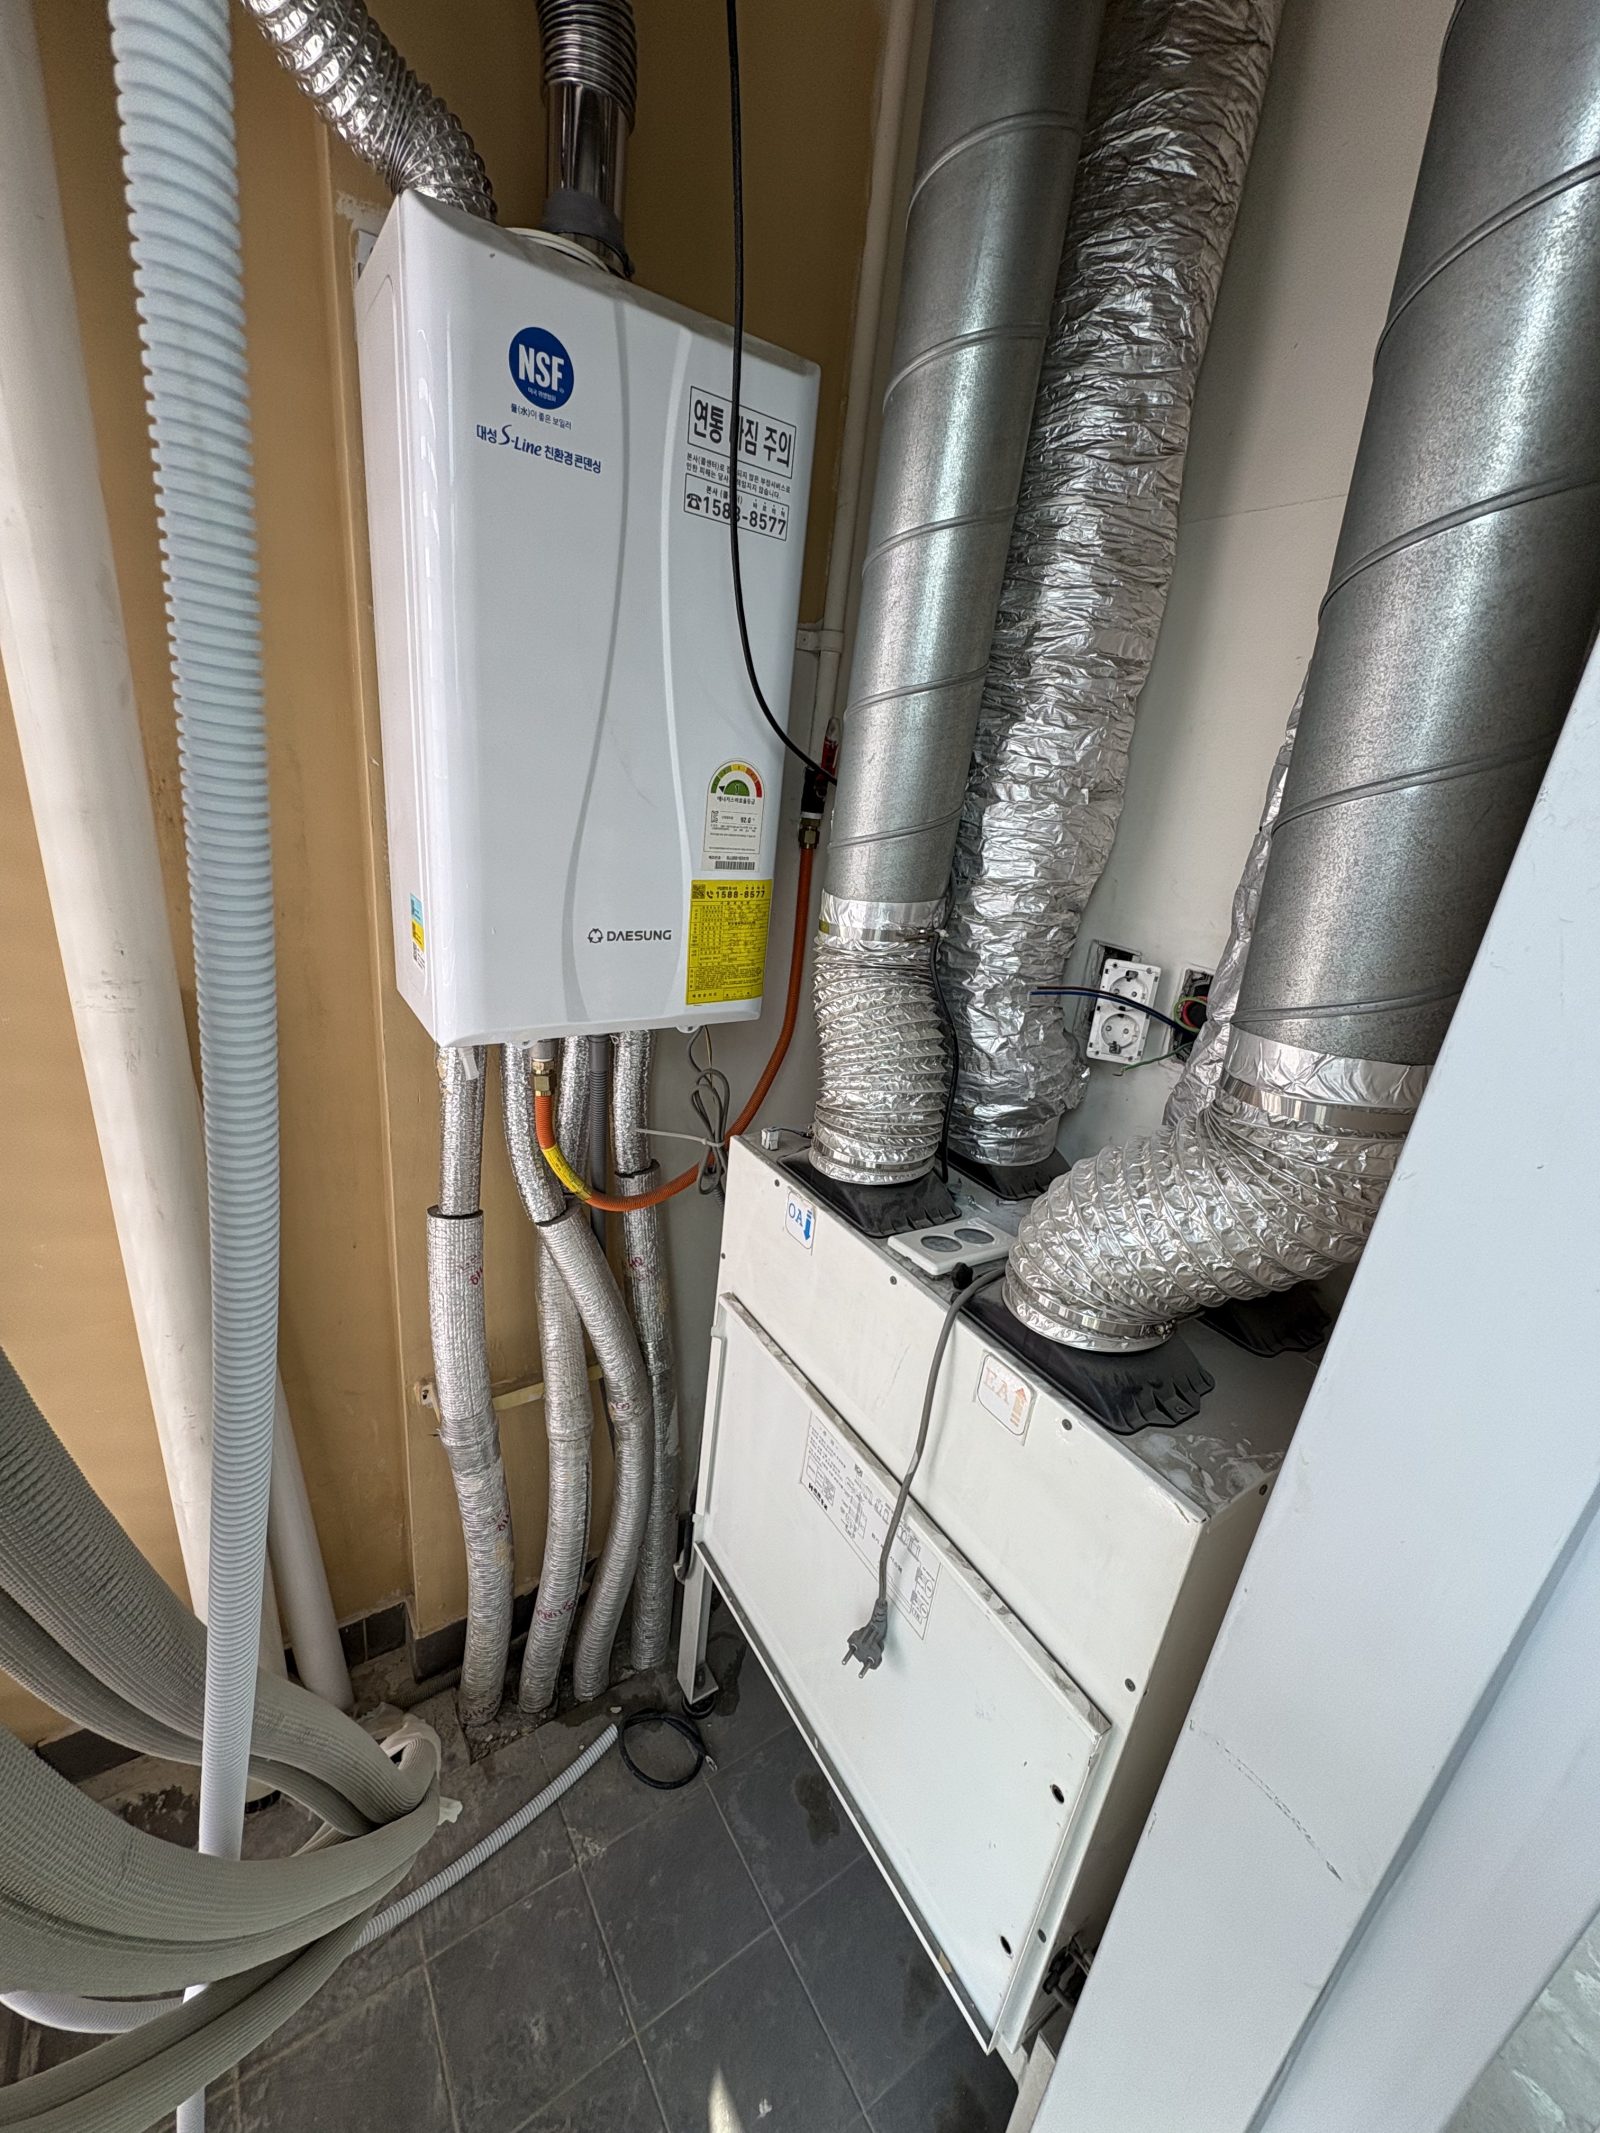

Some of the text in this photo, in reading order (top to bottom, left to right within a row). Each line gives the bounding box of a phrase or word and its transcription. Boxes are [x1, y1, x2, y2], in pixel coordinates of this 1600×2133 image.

[518, 343, 565, 392] NSF
[552, 416, 572, 430] 보일러
[693, 399, 724, 444] 연통
[763, 426, 792, 468] 주의
[476, 424, 498, 444] 대성
[498, 424, 542, 457] S-Line
[716, 890, 765, 899] 1588-8577
[607, 929, 672, 942] DAESUNG
[788, 1202, 804, 1227] OA
[983, 1366, 1010, 1406] EA
